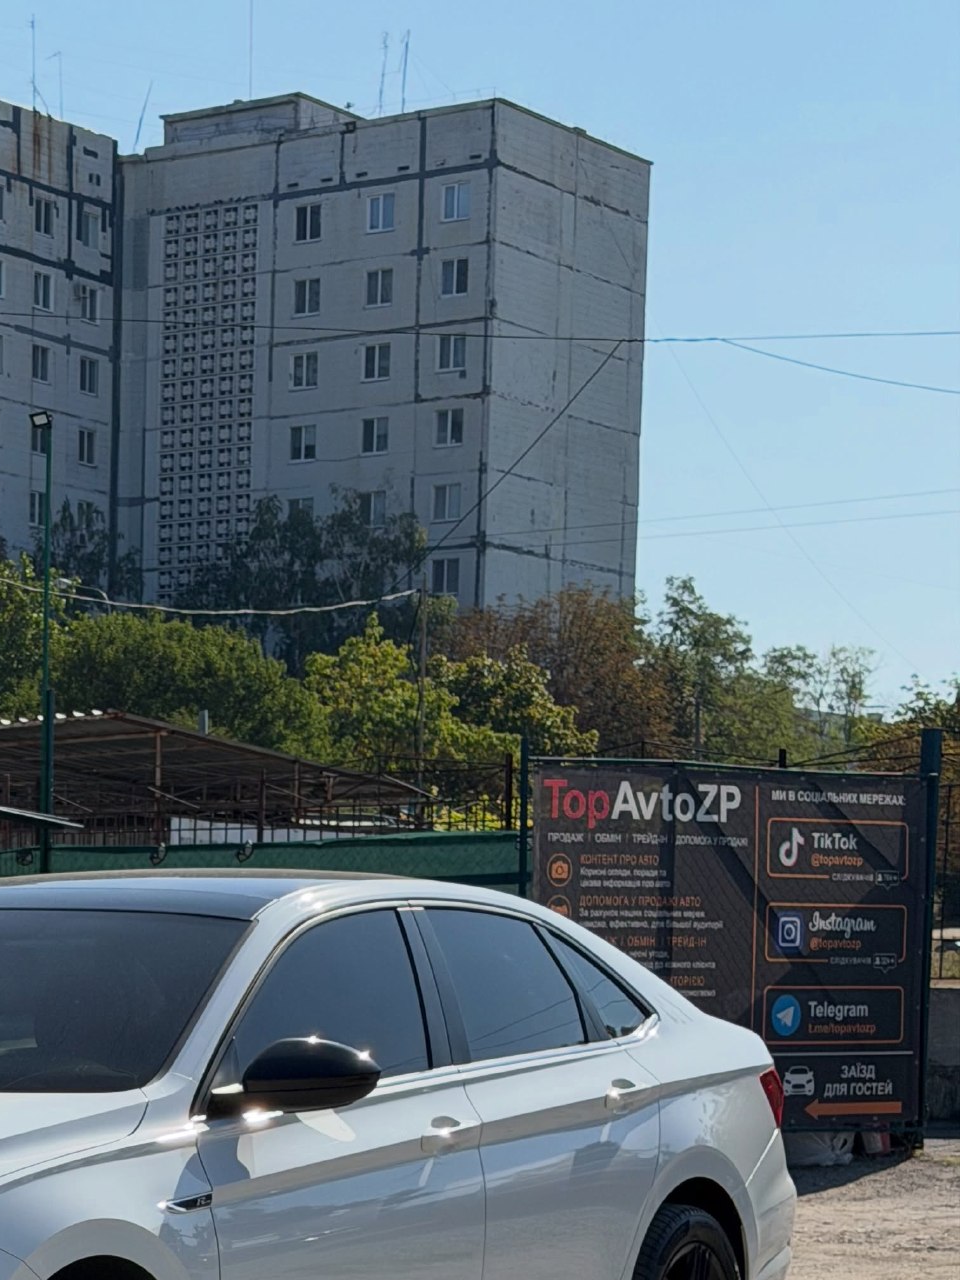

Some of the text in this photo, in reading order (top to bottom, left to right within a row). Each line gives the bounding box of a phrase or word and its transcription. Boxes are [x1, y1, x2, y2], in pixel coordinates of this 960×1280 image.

[544, 778, 741, 829] TopAvtoZP
[771, 790, 786, 801] МИ
[788, 790, 796, 801] В
[797, 791, 857, 804] СОЦІАЛЬНИХ
[547, 832, 584, 843] ПРОДАЖ
[595, 833, 621, 844] ОБМІН
[811, 832, 858, 850] TikTok
[580, 854, 659, 866] КОНТЕНТ ПРО АВТО
[810, 853, 863, 867] @topavtozp
[579, 895, 629, 907] ДОПОМОГА
[631, 896, 638, 907] У
[679, 896, 701, 907] АВТО
[808, 911, 877, 938] Instagram
[627, 936, 656, 946] ОБМІН
[808, 1001, 869, 1020] Telegram
[840, 1062, 876, 1080] ЗАЇЗД
[824, 1079, 893, 1098] ДЛЯ ГОСТЕЙ
